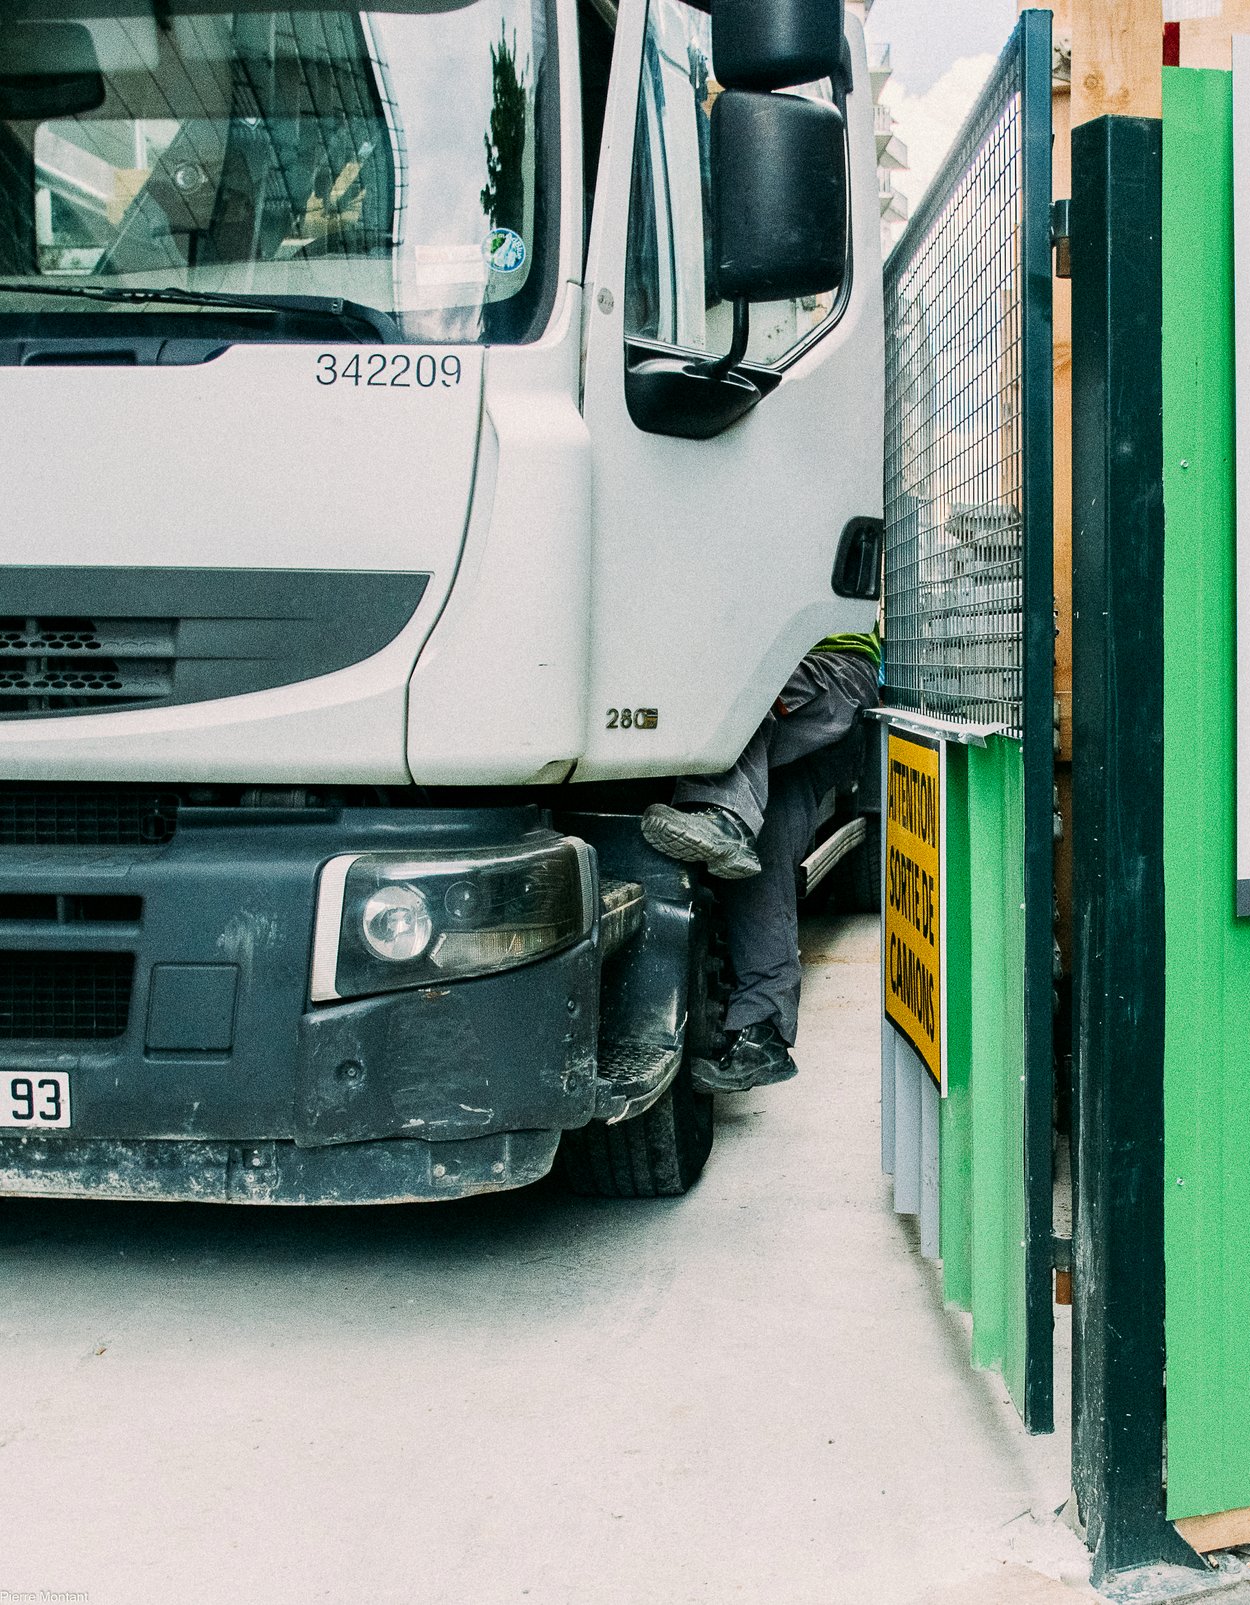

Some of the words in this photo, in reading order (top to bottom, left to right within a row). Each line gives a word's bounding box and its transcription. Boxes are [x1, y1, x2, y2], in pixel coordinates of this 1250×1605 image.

[316, 353, 461, 387] 342209
[889, 758, 936, 848] ATTENTION
[889, 845, 920, 932] SORTIE
[922, 869, 935, 947] DE
[890, 932, 935, 1043] CAMIONS
[11, 1078, 61, 1120] 93
